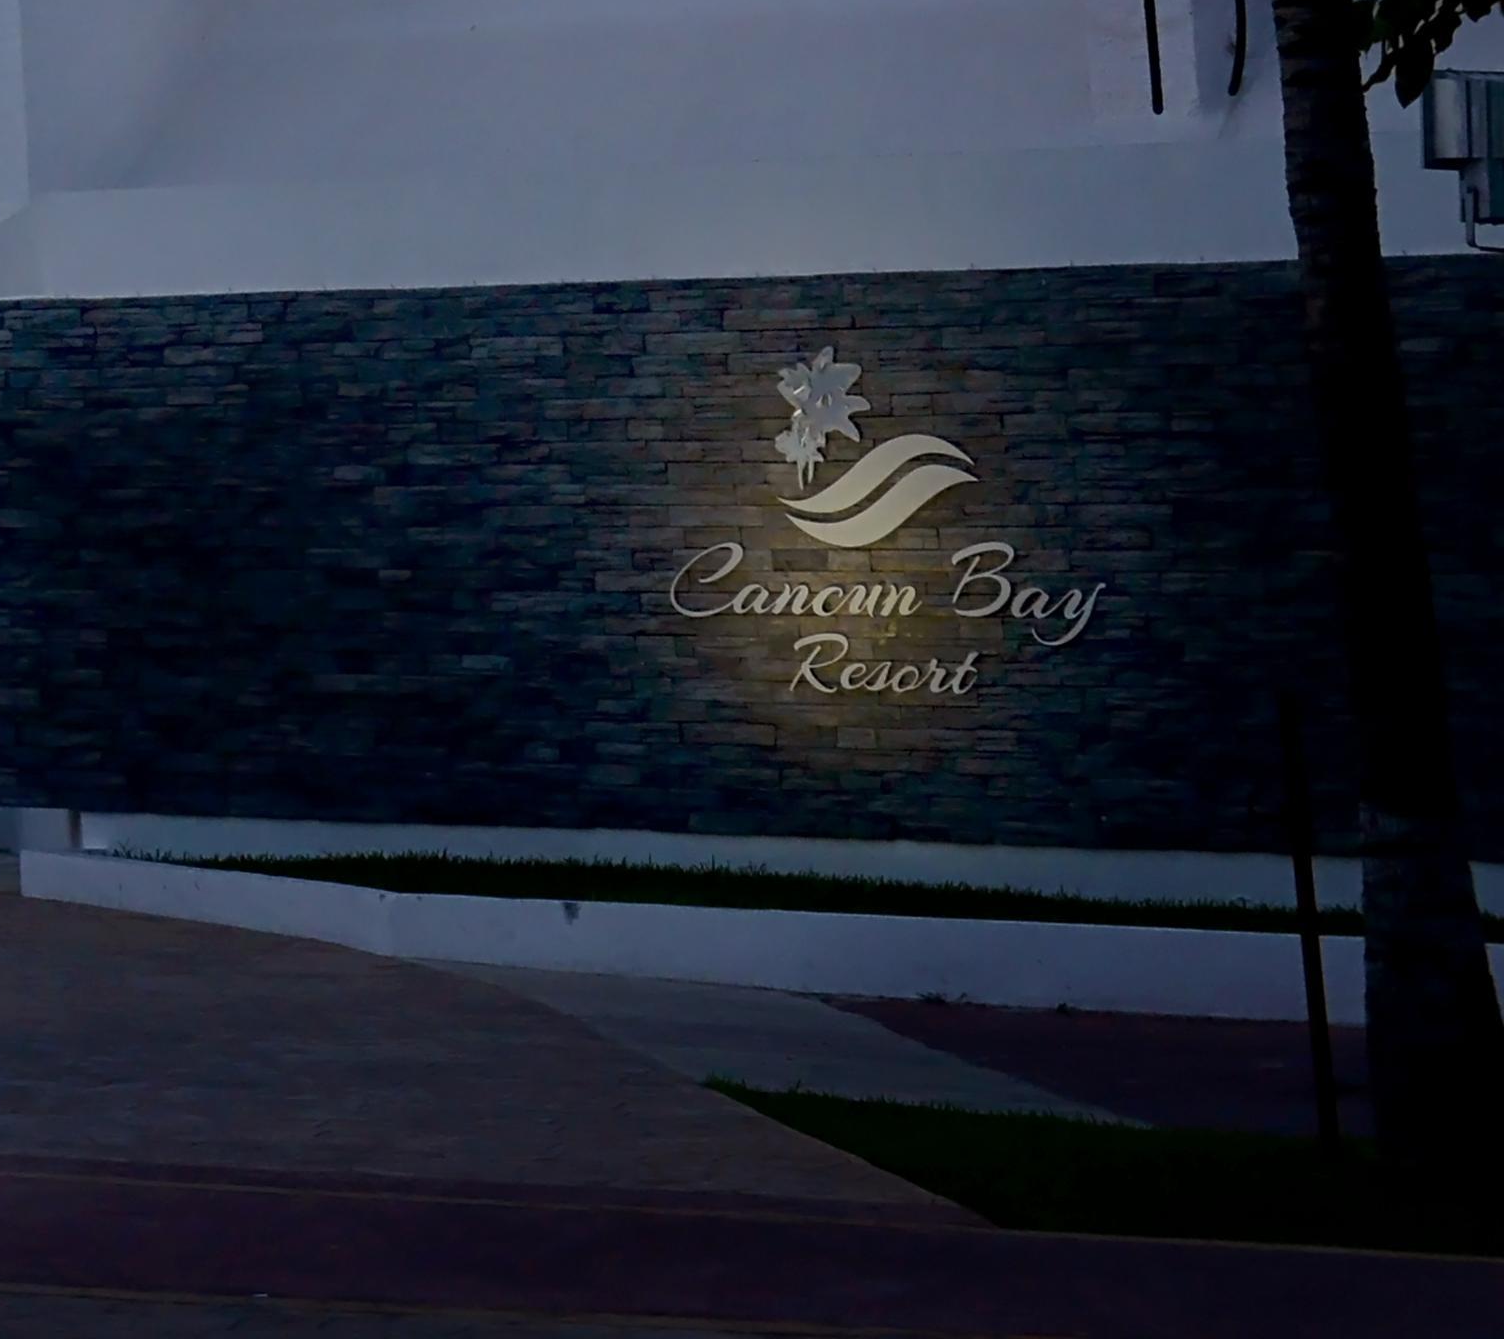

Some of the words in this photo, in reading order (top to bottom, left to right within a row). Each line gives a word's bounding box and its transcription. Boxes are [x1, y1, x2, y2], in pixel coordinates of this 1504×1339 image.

[670, 541, 922, 619] Cancun
[952, 541, 1107, 646] Bay
[789, 633, 981, 695] Resort
